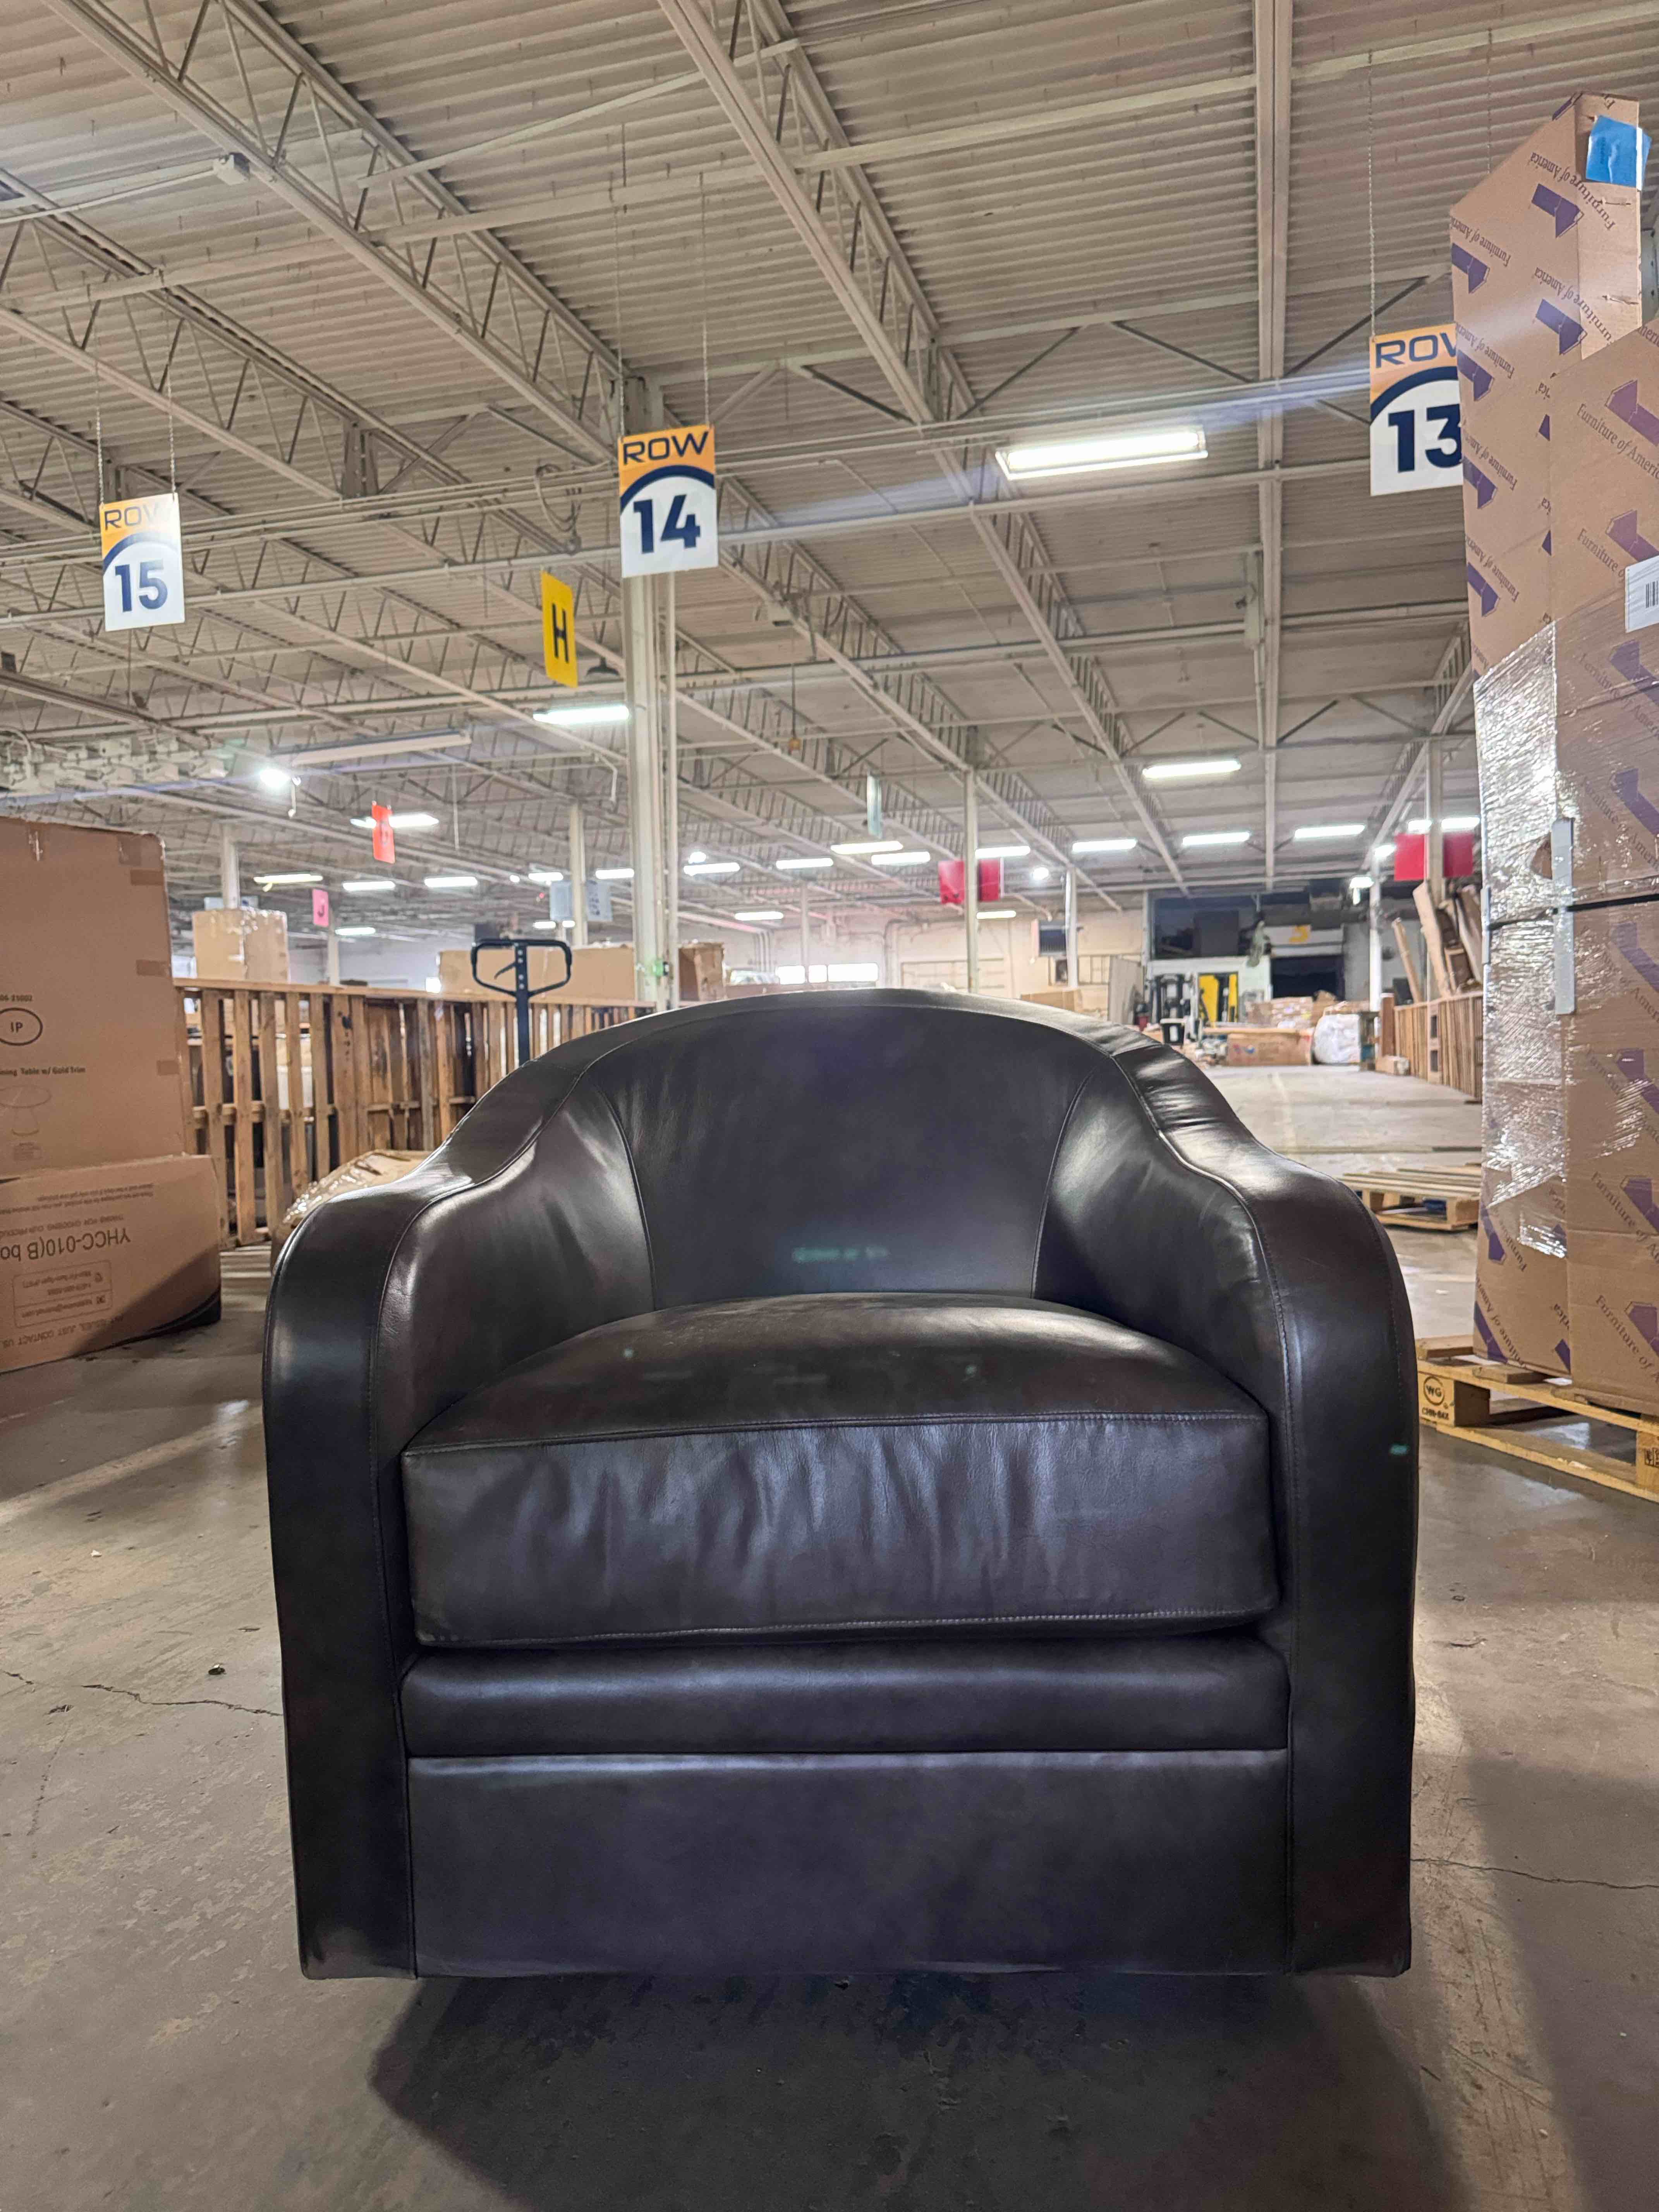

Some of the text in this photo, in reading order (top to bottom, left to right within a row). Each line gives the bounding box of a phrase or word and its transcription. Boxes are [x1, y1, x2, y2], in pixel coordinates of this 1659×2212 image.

[1530, 152, 1616, 230] Furniture of America
[1480, 237, 1511, 267] Furniture
[1534, 267, 1613, 344] urniture of America
[1484, 346, 1515, 379] Furniture
[623, 431, 709, 464] ROW
[1388, 404, 1462, 473] 13
[1577, 403, 1659, 480] Furniture of Americ
[1489, 455, 1518, 491] Furniture
[634, 494, 700, 554] 14
[1577, 528, 1618, 572] Furniture
[115, 559, 168, 613] 15
[552, 603, 569, 664] H
[10, 1022, 23, 1033] IP
[0, 1228, 131, 1262] YHCC-010(B bo
